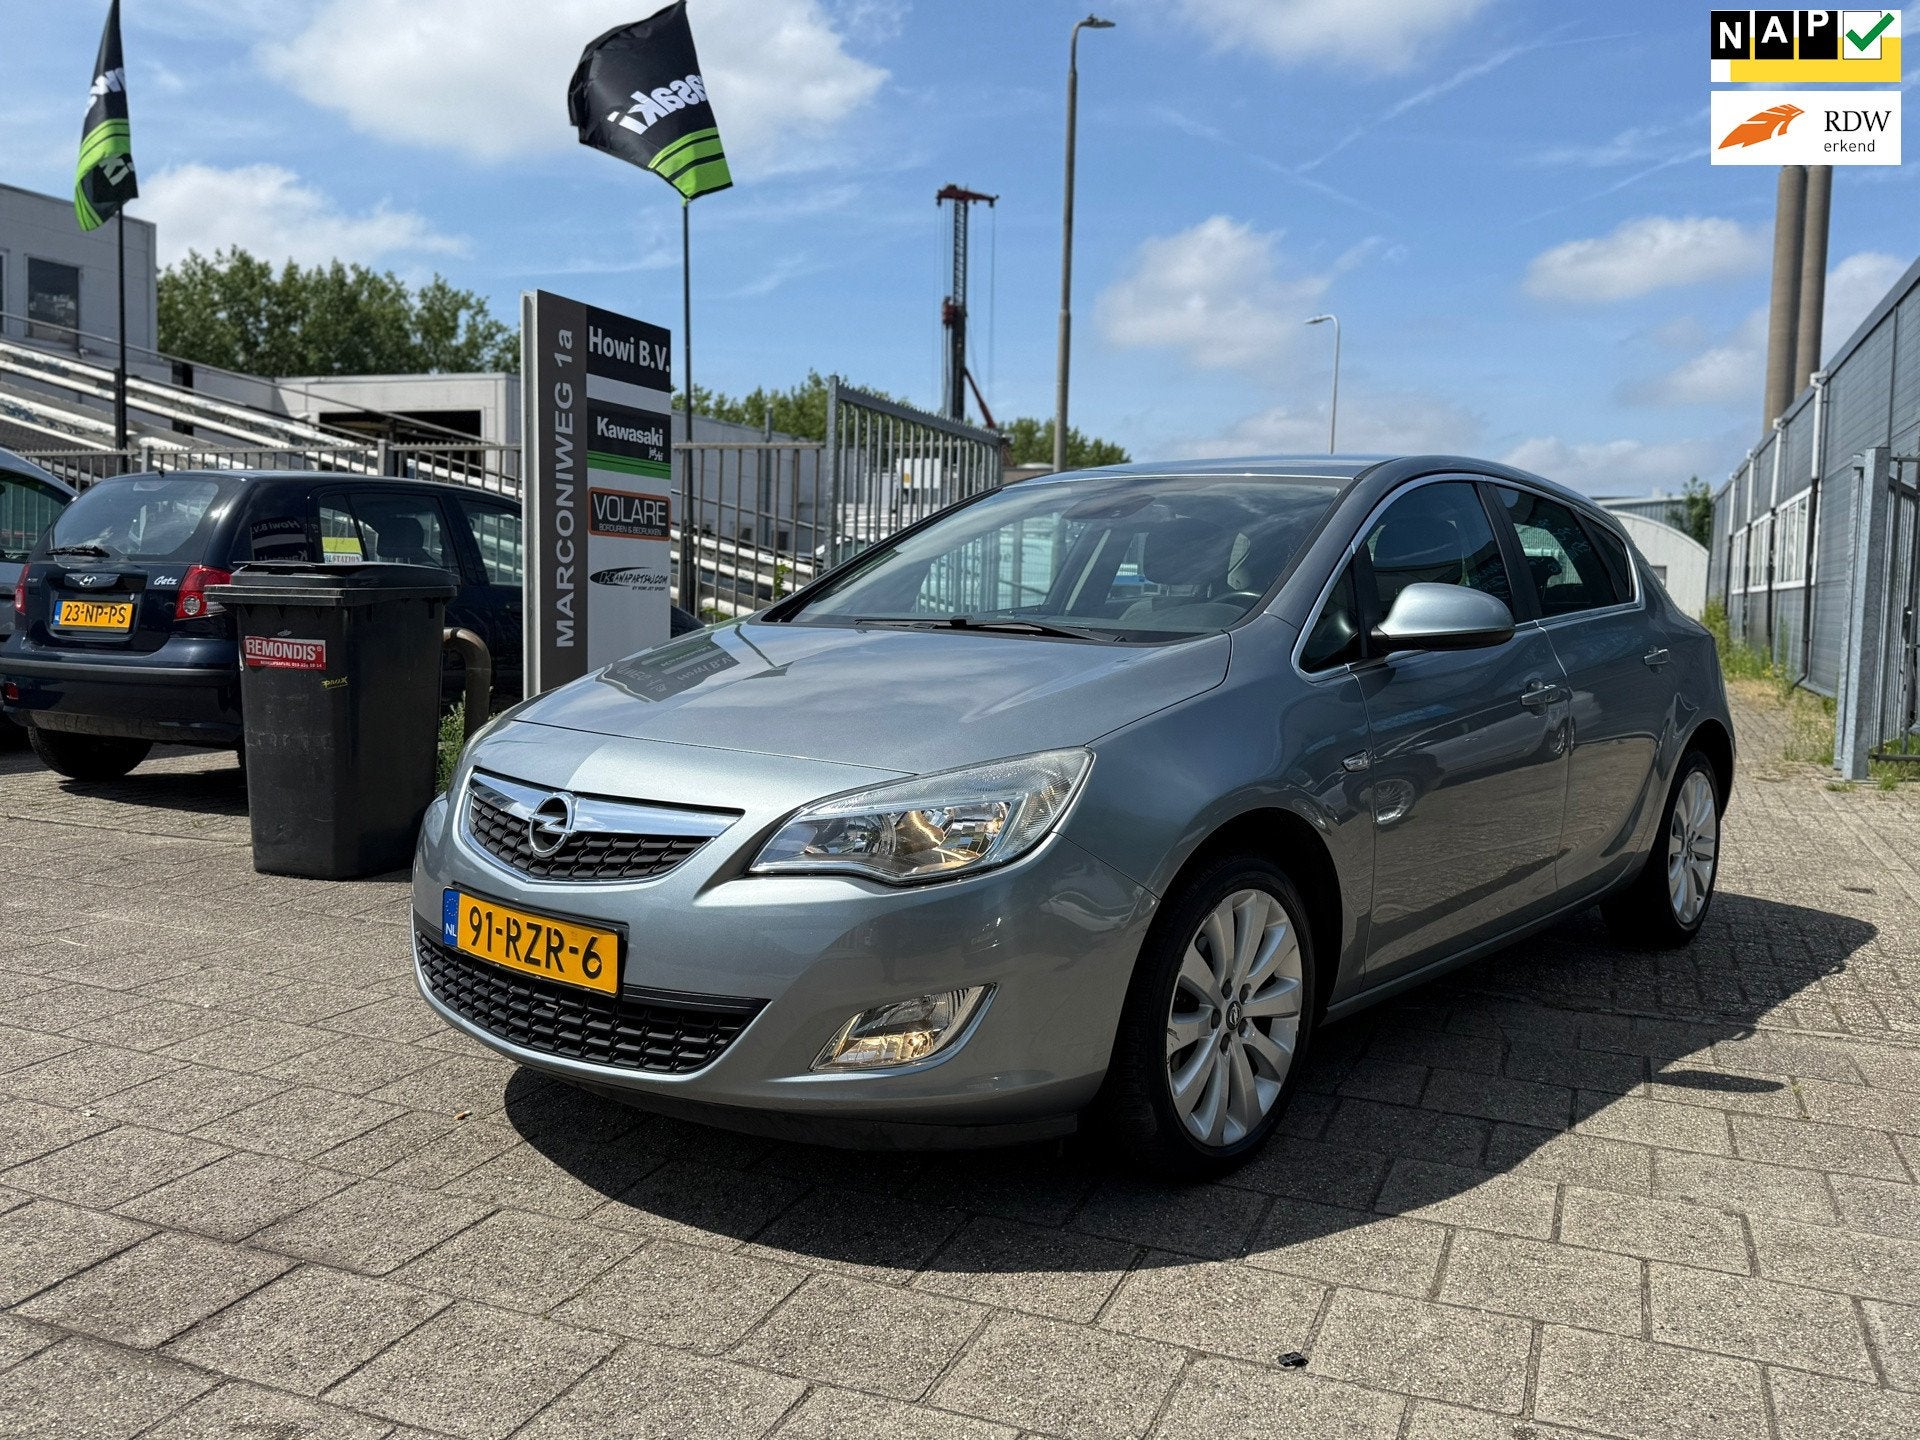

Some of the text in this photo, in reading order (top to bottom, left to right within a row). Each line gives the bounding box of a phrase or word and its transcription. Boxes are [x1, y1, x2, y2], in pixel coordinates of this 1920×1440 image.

[588, 325, 670, 373] Howi B.V.
[596, 415, 663, 447] Kawasaki
[554, 329, 575, 647] MARCONIWEG 1a
[593, 493, 666, 527] VOLARE
[154, 575, 178, 586] Getz
[64, 604, 127, 624] 23-NP-PS
[446, 923, 457, 937] NL
[469, 905, 603, 980] 91-RZR-6
